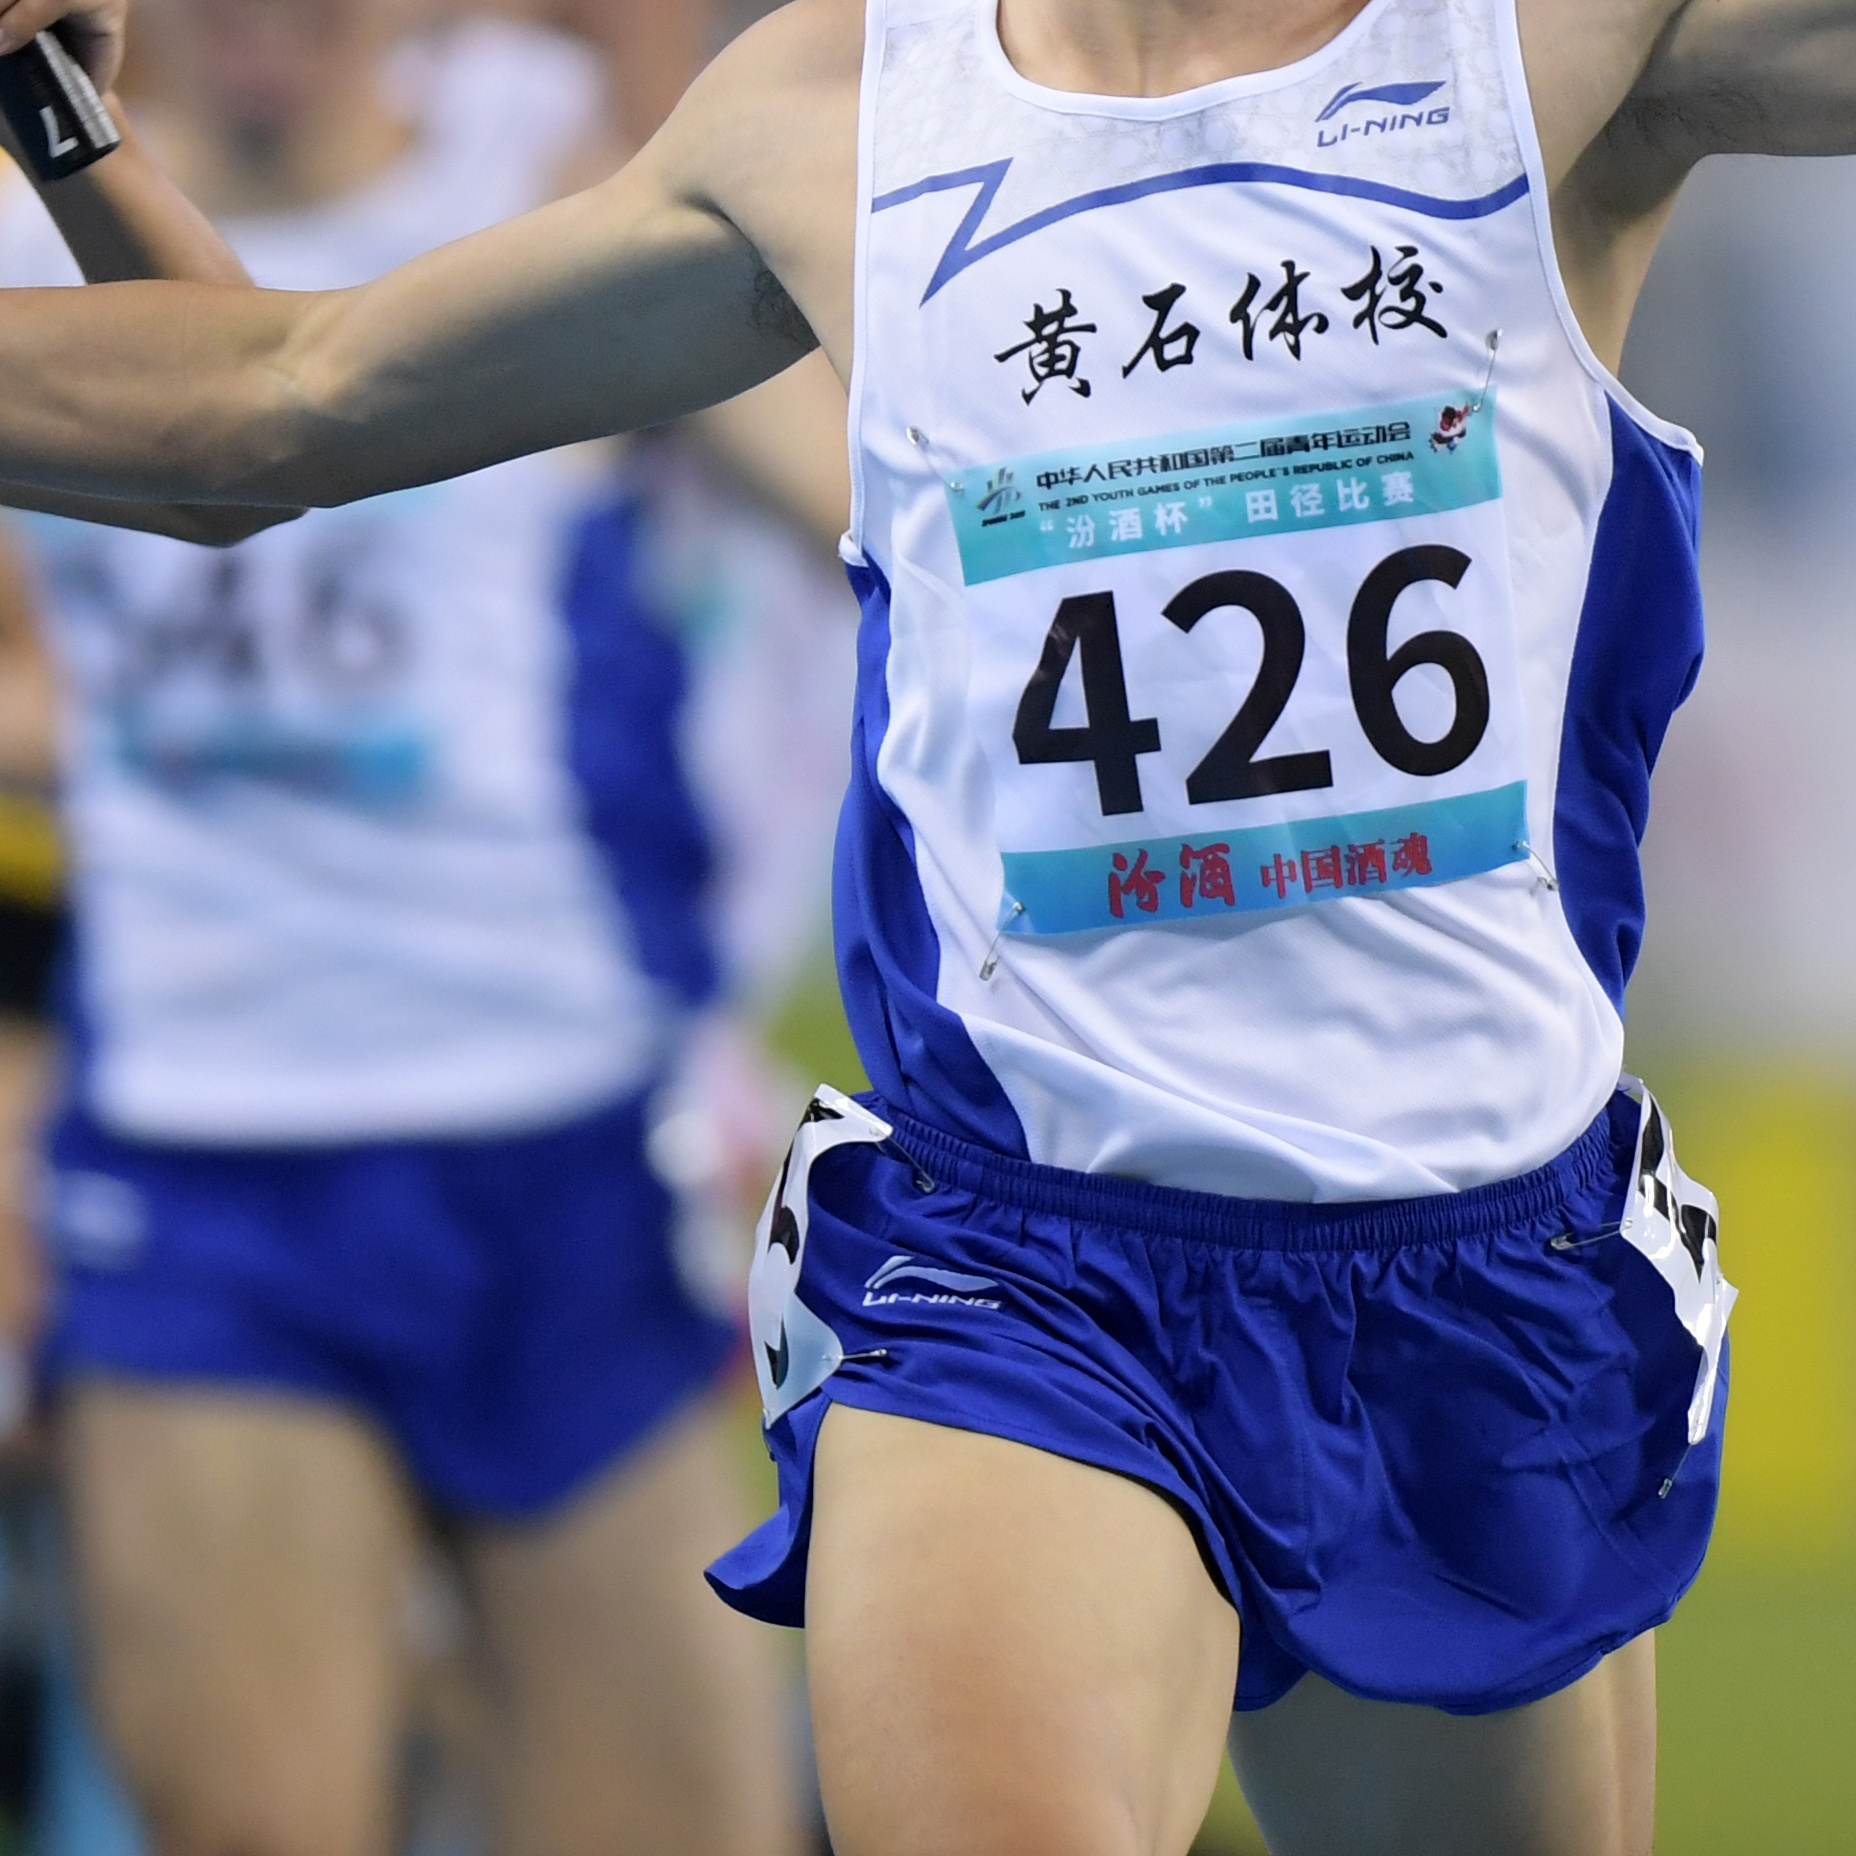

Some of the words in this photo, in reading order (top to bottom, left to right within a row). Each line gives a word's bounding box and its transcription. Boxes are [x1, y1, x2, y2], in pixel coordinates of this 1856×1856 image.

[38, 104, 79, 159] 7
[1316, 106, 1451, 148] LI-NING
[994, 245, 1450, 406] 黄石体校
[1035, 420, 1412, 491] 中华人民共和国第二届青年运动会
[1038, 501, 1061, 512] THE
[1066, 495, 1089, 508] 2ND
[1093, 488, 1134, 503] YOUTH
[1137, 482, 1181, 496] GAMES
[1183, 479, 1200, 490] OF
[1203, 475, 1226, 487] THE
[1293, 458, 1353, 475] REPUBLIC
[1355, 455, 1373, 468] OF
[1376, 450, 1415, 464] CHINA
[1245, 470, 1414, 524] 田径比赛
[1010, 542, 1492, 818] 426
[1107, 842, 1236, 919] 汾酒
[1260, 832, 1433, 900] 中国酒魂
[862, 1291, 1002, 1310] LI-NING
